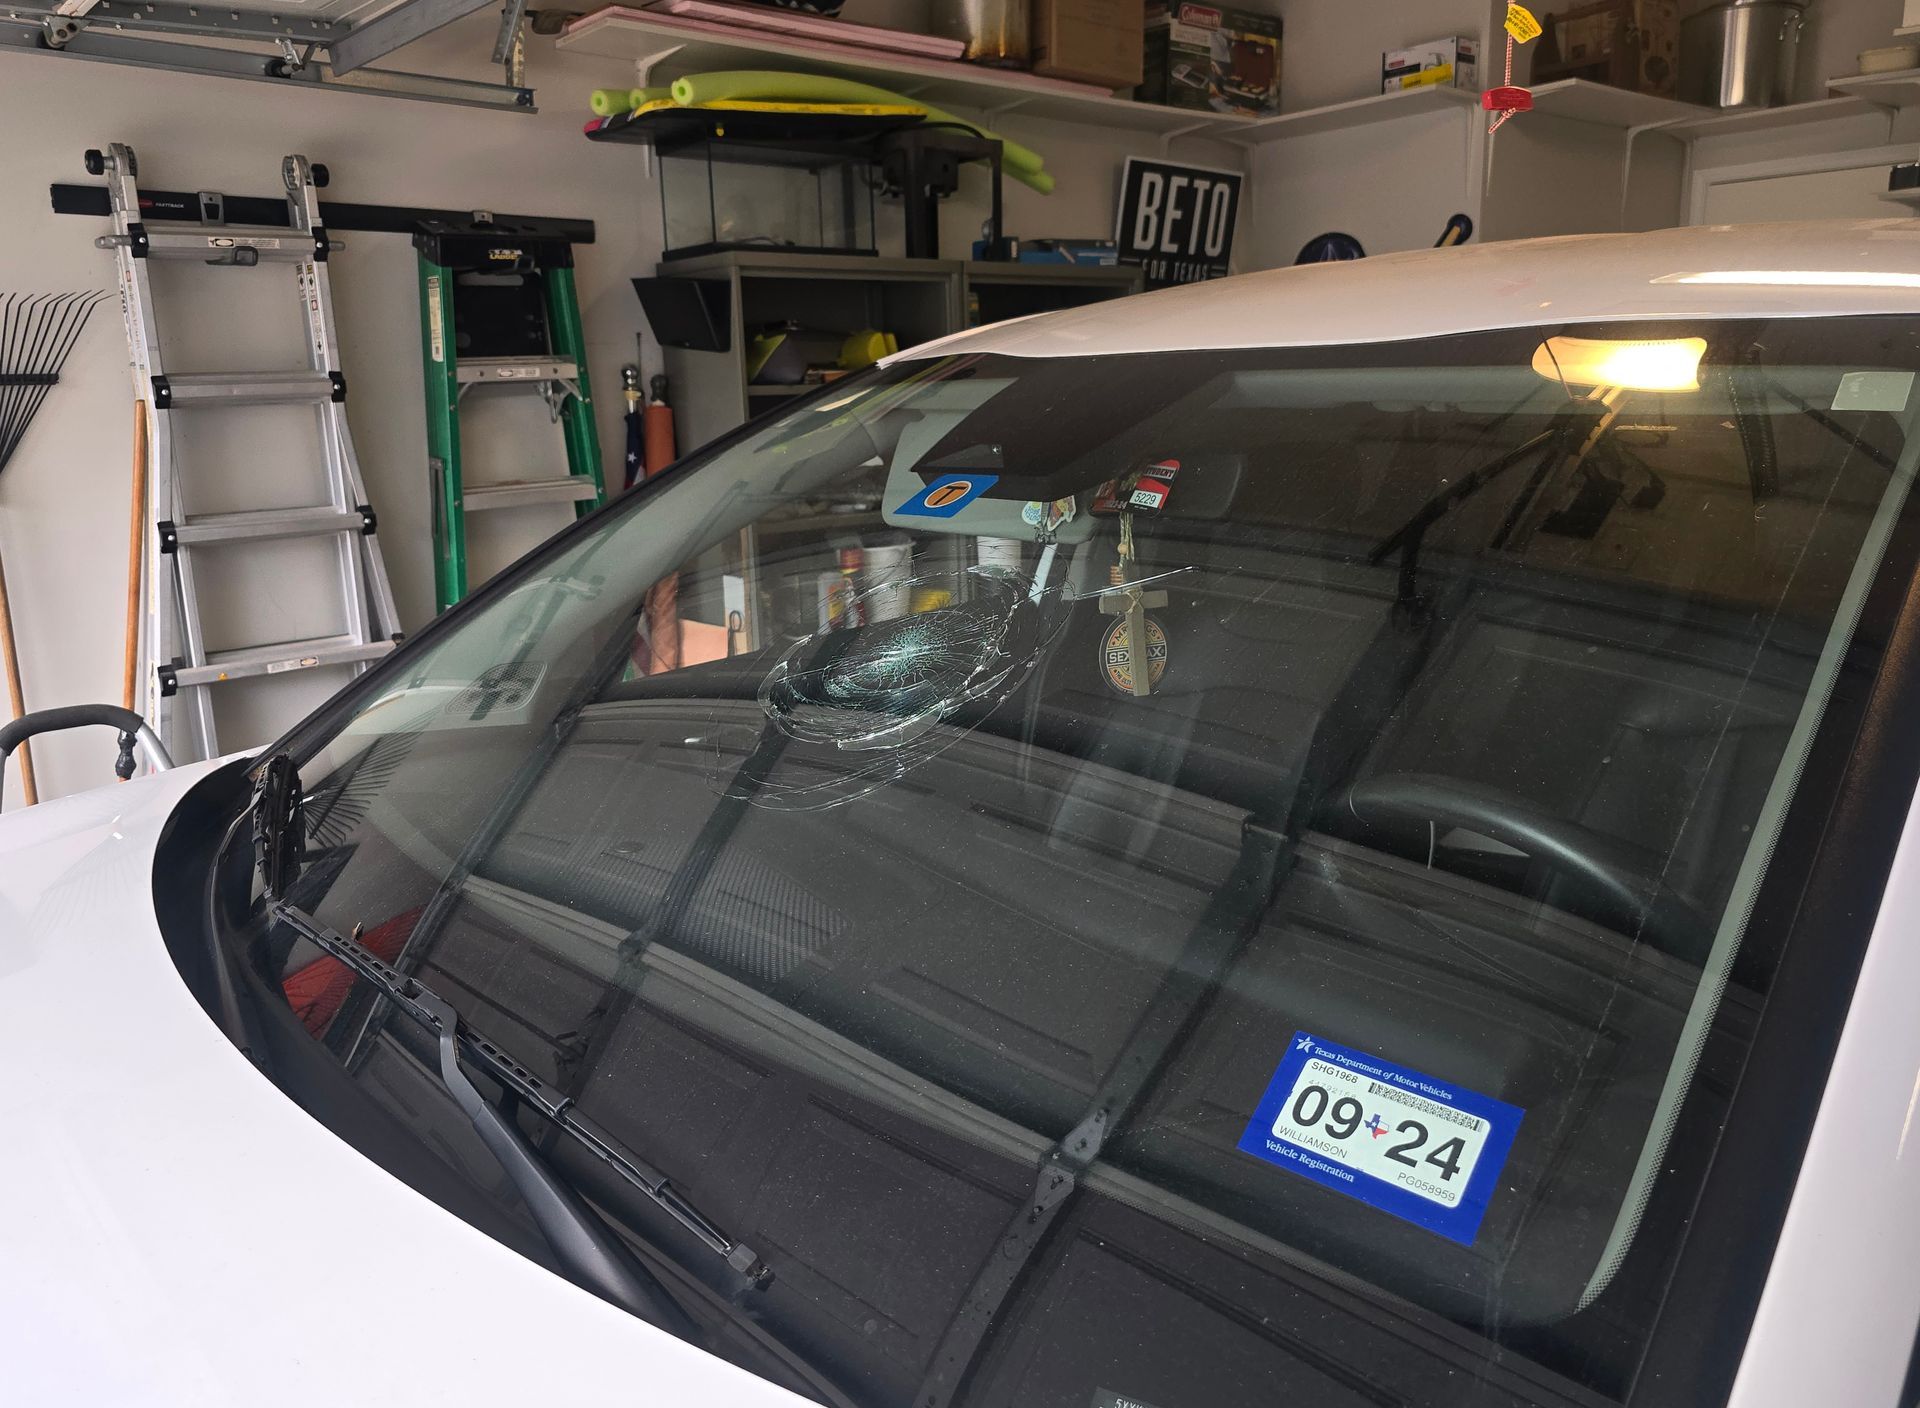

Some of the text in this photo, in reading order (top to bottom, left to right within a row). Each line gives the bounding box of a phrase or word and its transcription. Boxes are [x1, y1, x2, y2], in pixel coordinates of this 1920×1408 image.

[1133, 172, 1230, 257] BETO
[1134, 492, 1157, 506] 5229
[1311, 1061, 1359, 1084] SHG1968
[1314, 1047, 1453, 1100] Texas Department of Motor Vehicles
[1279, 1125, 1348, 1159] WILLIAMSON
[1292, 1085, 1466, 1182] 09 24
[1266, 1139, 1355, 1183] Vehicle Registration
[1396, 1172, 1456, 1202] PG058959
